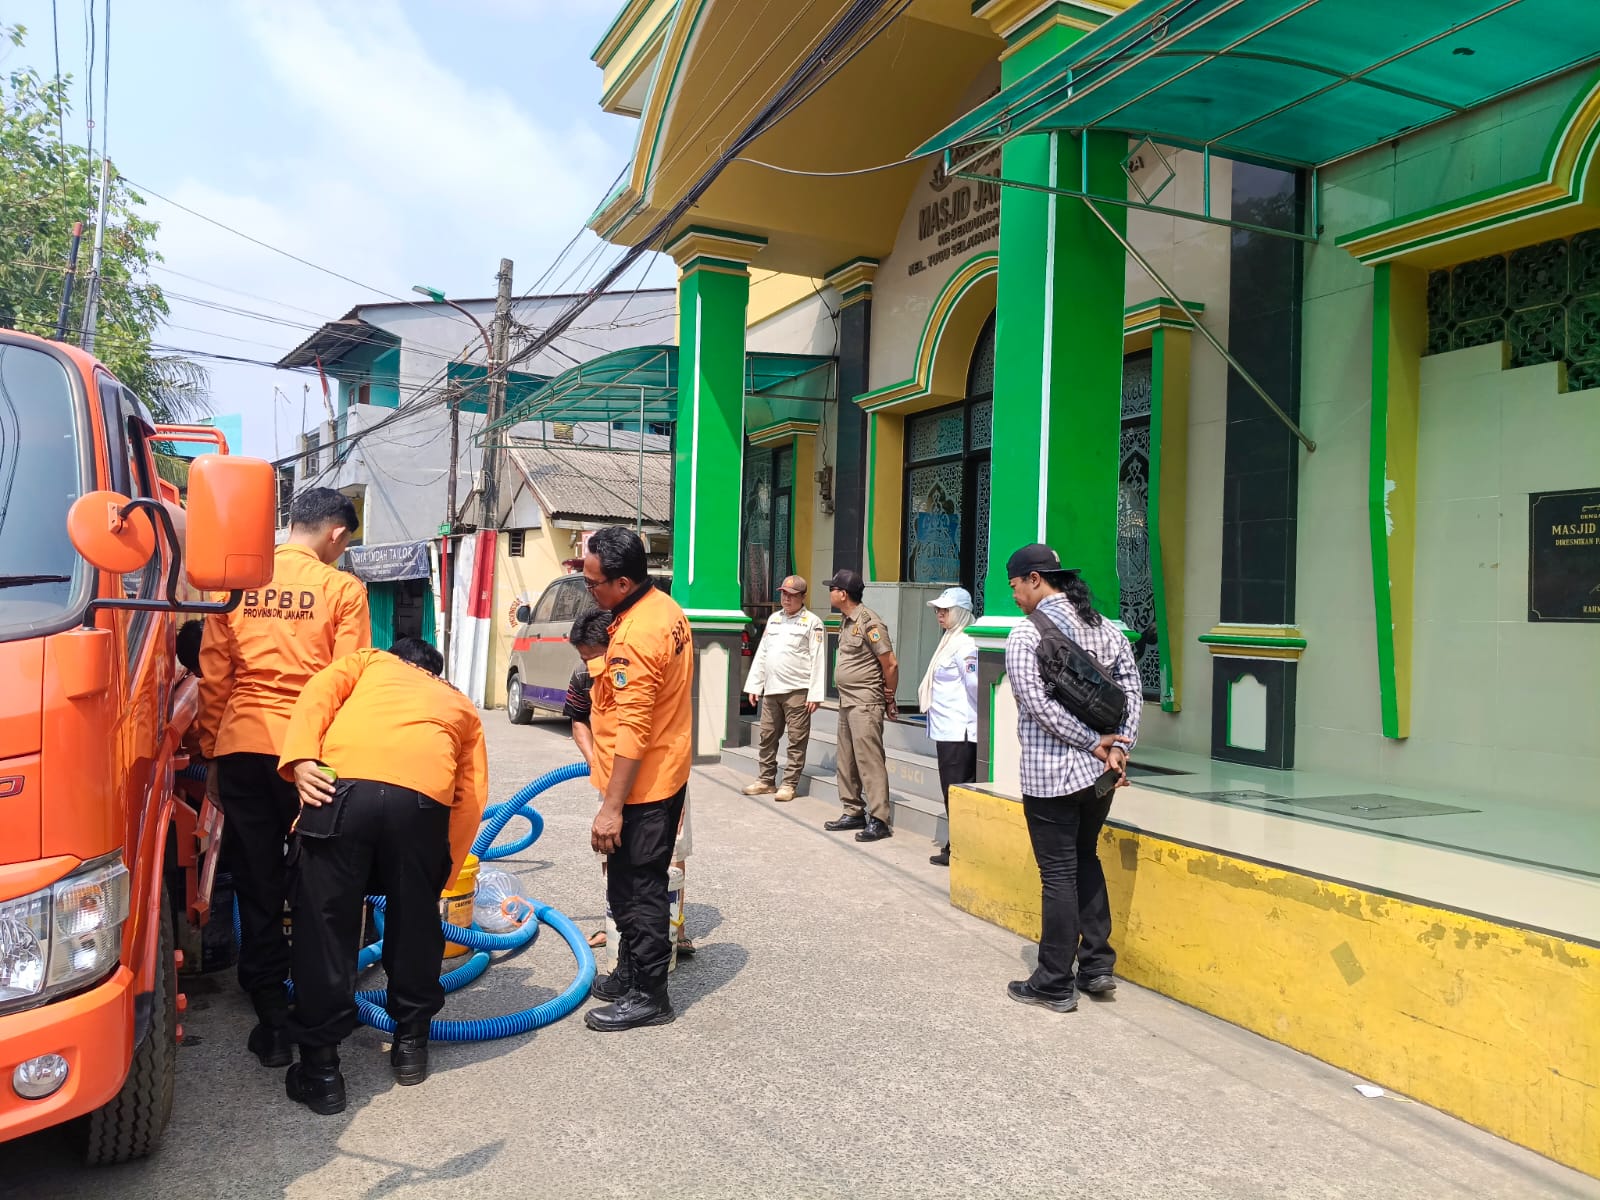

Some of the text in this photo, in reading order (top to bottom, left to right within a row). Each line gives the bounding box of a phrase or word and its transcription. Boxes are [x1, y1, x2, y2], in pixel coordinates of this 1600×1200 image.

[918, 187, 971, 242] MASJID
[951, 208, 1000, 240] BENDUNGA
[951, 228, 991, 256] SELATAN
[1551, 522, 1596, 536] MASJID
[389, 546, 413, 560] TAILOR
[244, 589, 315, 609] BPBD
[243, 608, 272, 618] PROVINSI
[284, 610, 314, 620] JAKARTA
